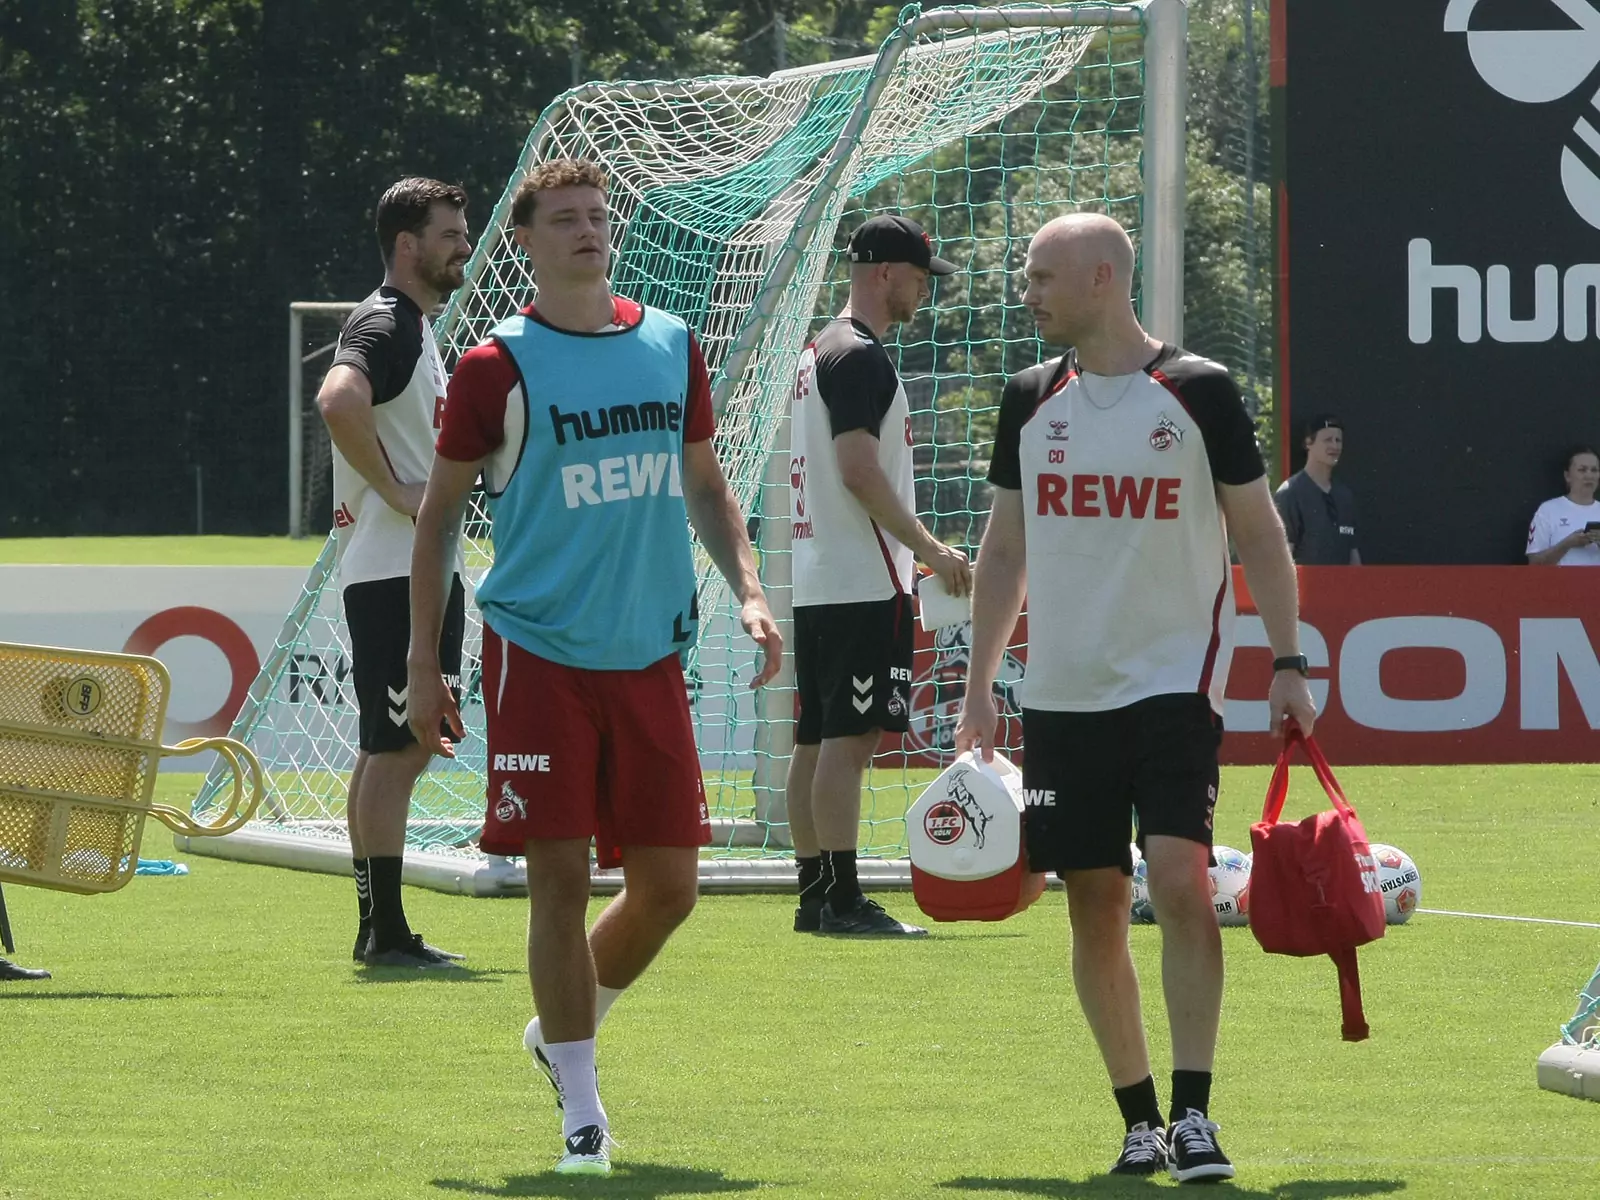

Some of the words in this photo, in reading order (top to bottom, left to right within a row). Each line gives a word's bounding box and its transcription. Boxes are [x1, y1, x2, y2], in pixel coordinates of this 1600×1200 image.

[1036, 473, 1182, 520] REWE
[890, 667, 912, 682] REW
[493, 754, 551, 772] REWE
[1023, 788, 1056, 806] WE
[931, 817, 957, 828] 1.FC
[1214, 901, 1233, 913] TAR
